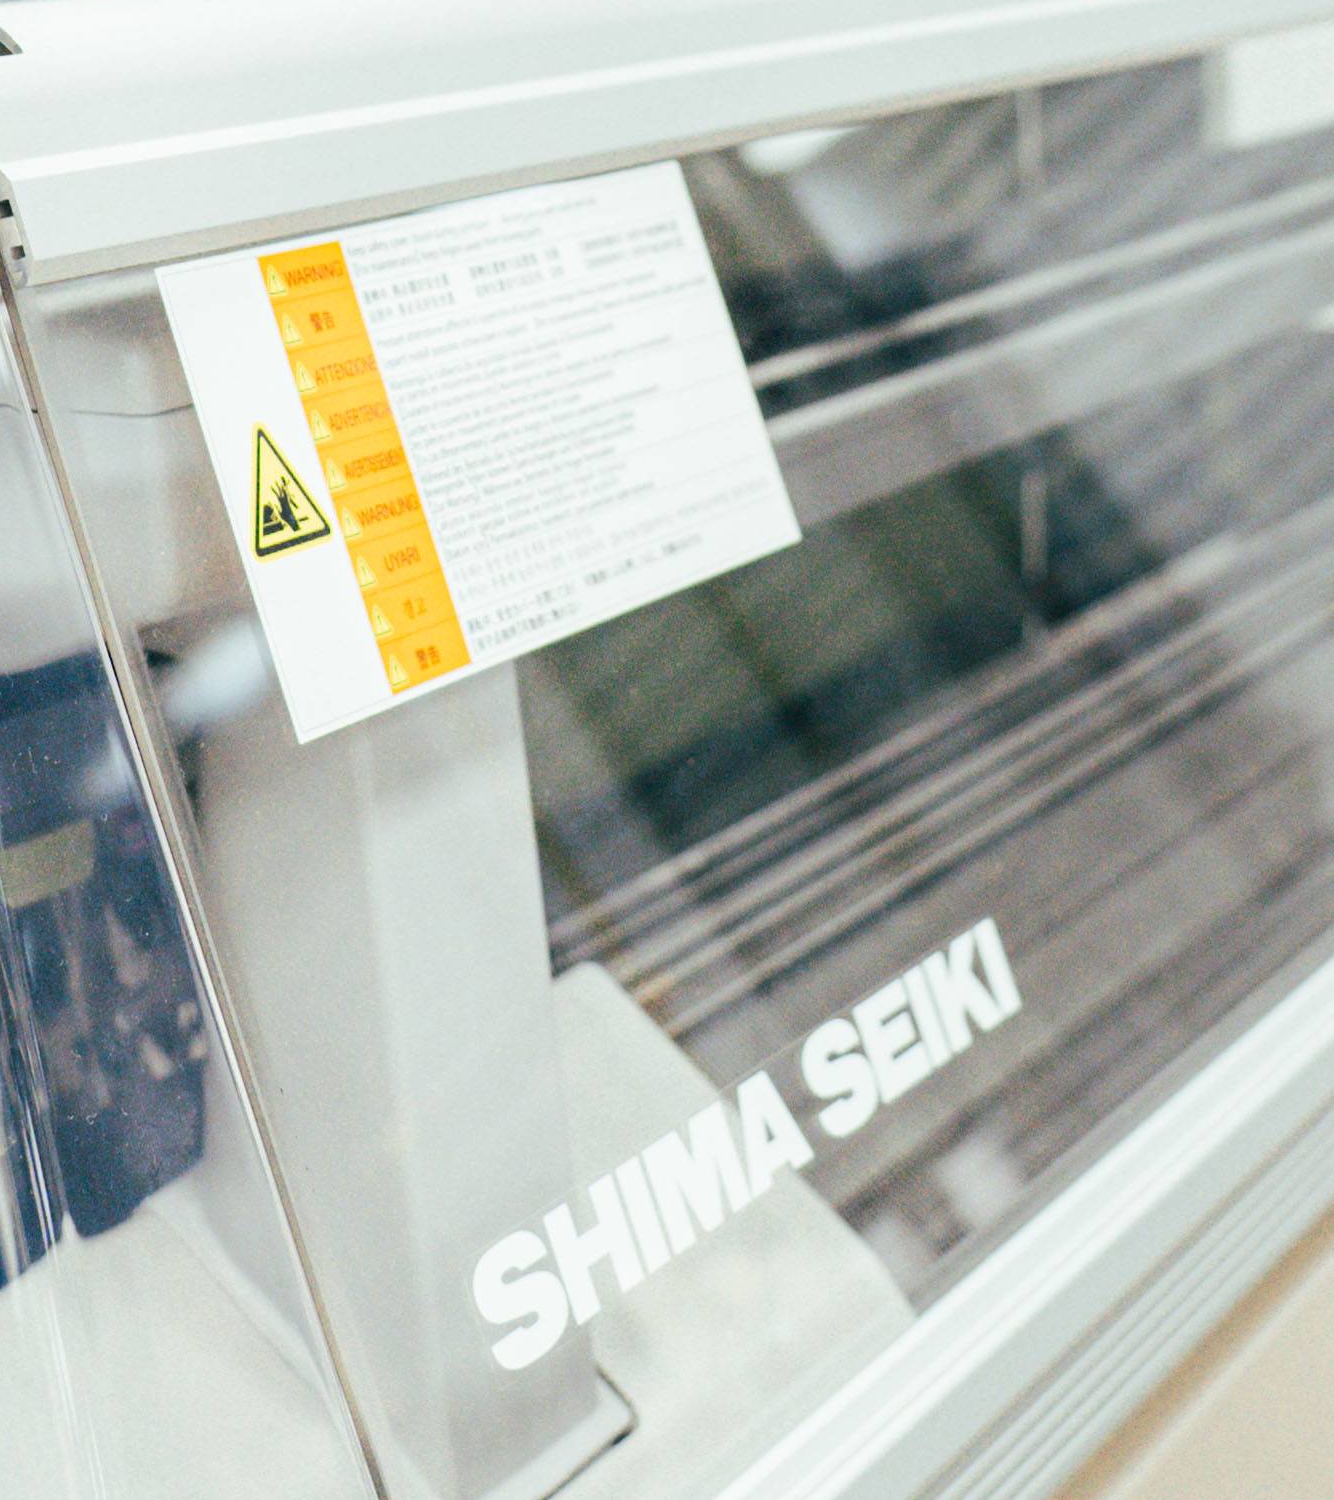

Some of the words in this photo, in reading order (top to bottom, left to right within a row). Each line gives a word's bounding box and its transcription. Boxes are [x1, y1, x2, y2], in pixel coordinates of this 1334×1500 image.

[283, 260, 344, 288] WARNING
[356, 492, 419, 526] WARNUNG
[383, 546, 421, 573] UYARI
[470, 1069, 815, 1371] SHIMA
[799, 915, 1023, 1139] SEIKI
